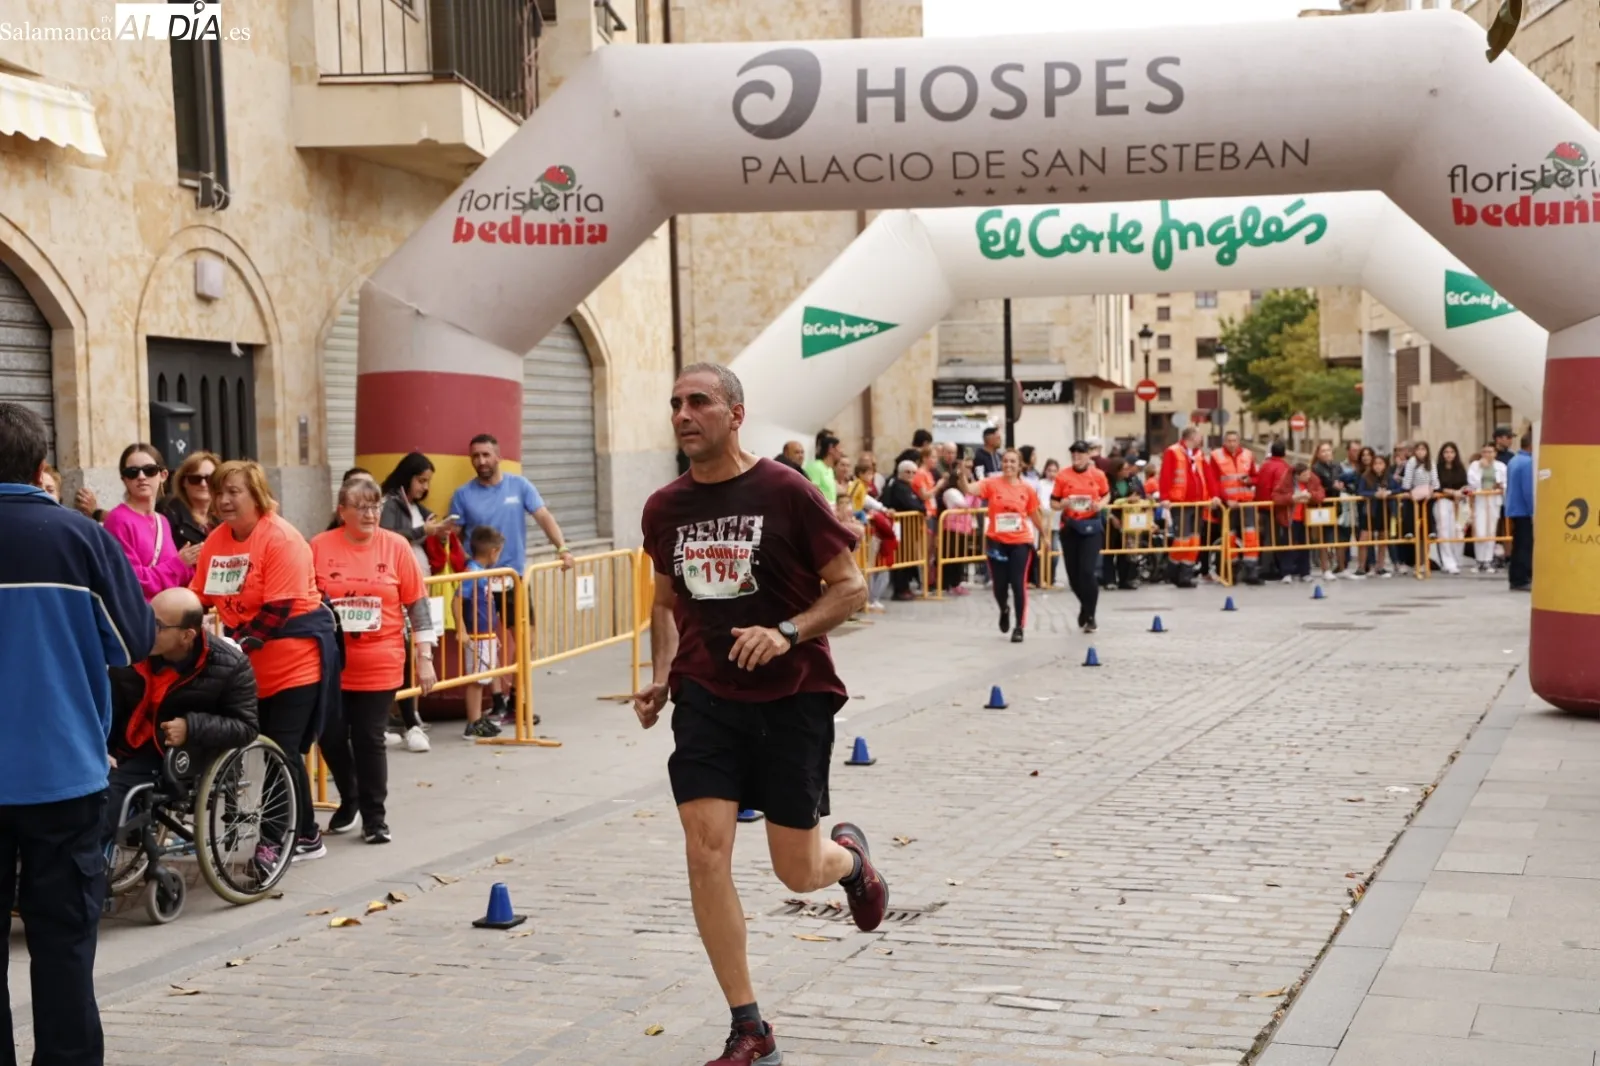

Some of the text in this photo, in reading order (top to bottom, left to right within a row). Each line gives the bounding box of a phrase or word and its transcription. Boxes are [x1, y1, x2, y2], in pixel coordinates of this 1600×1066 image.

[856, 56, 1184, 123] HOSPES
[741, 138, 1310, 184] PALACIO DE SAN ESTEBAN
[1447, 161, 1600, 193] floristerí
[457, 185, 604, 213] floristería
[452, 215, 608, 246] bedunia
[976, 199, 1328, 272] El Corte Inglés
[684, 544, 750, 561] bedunia
